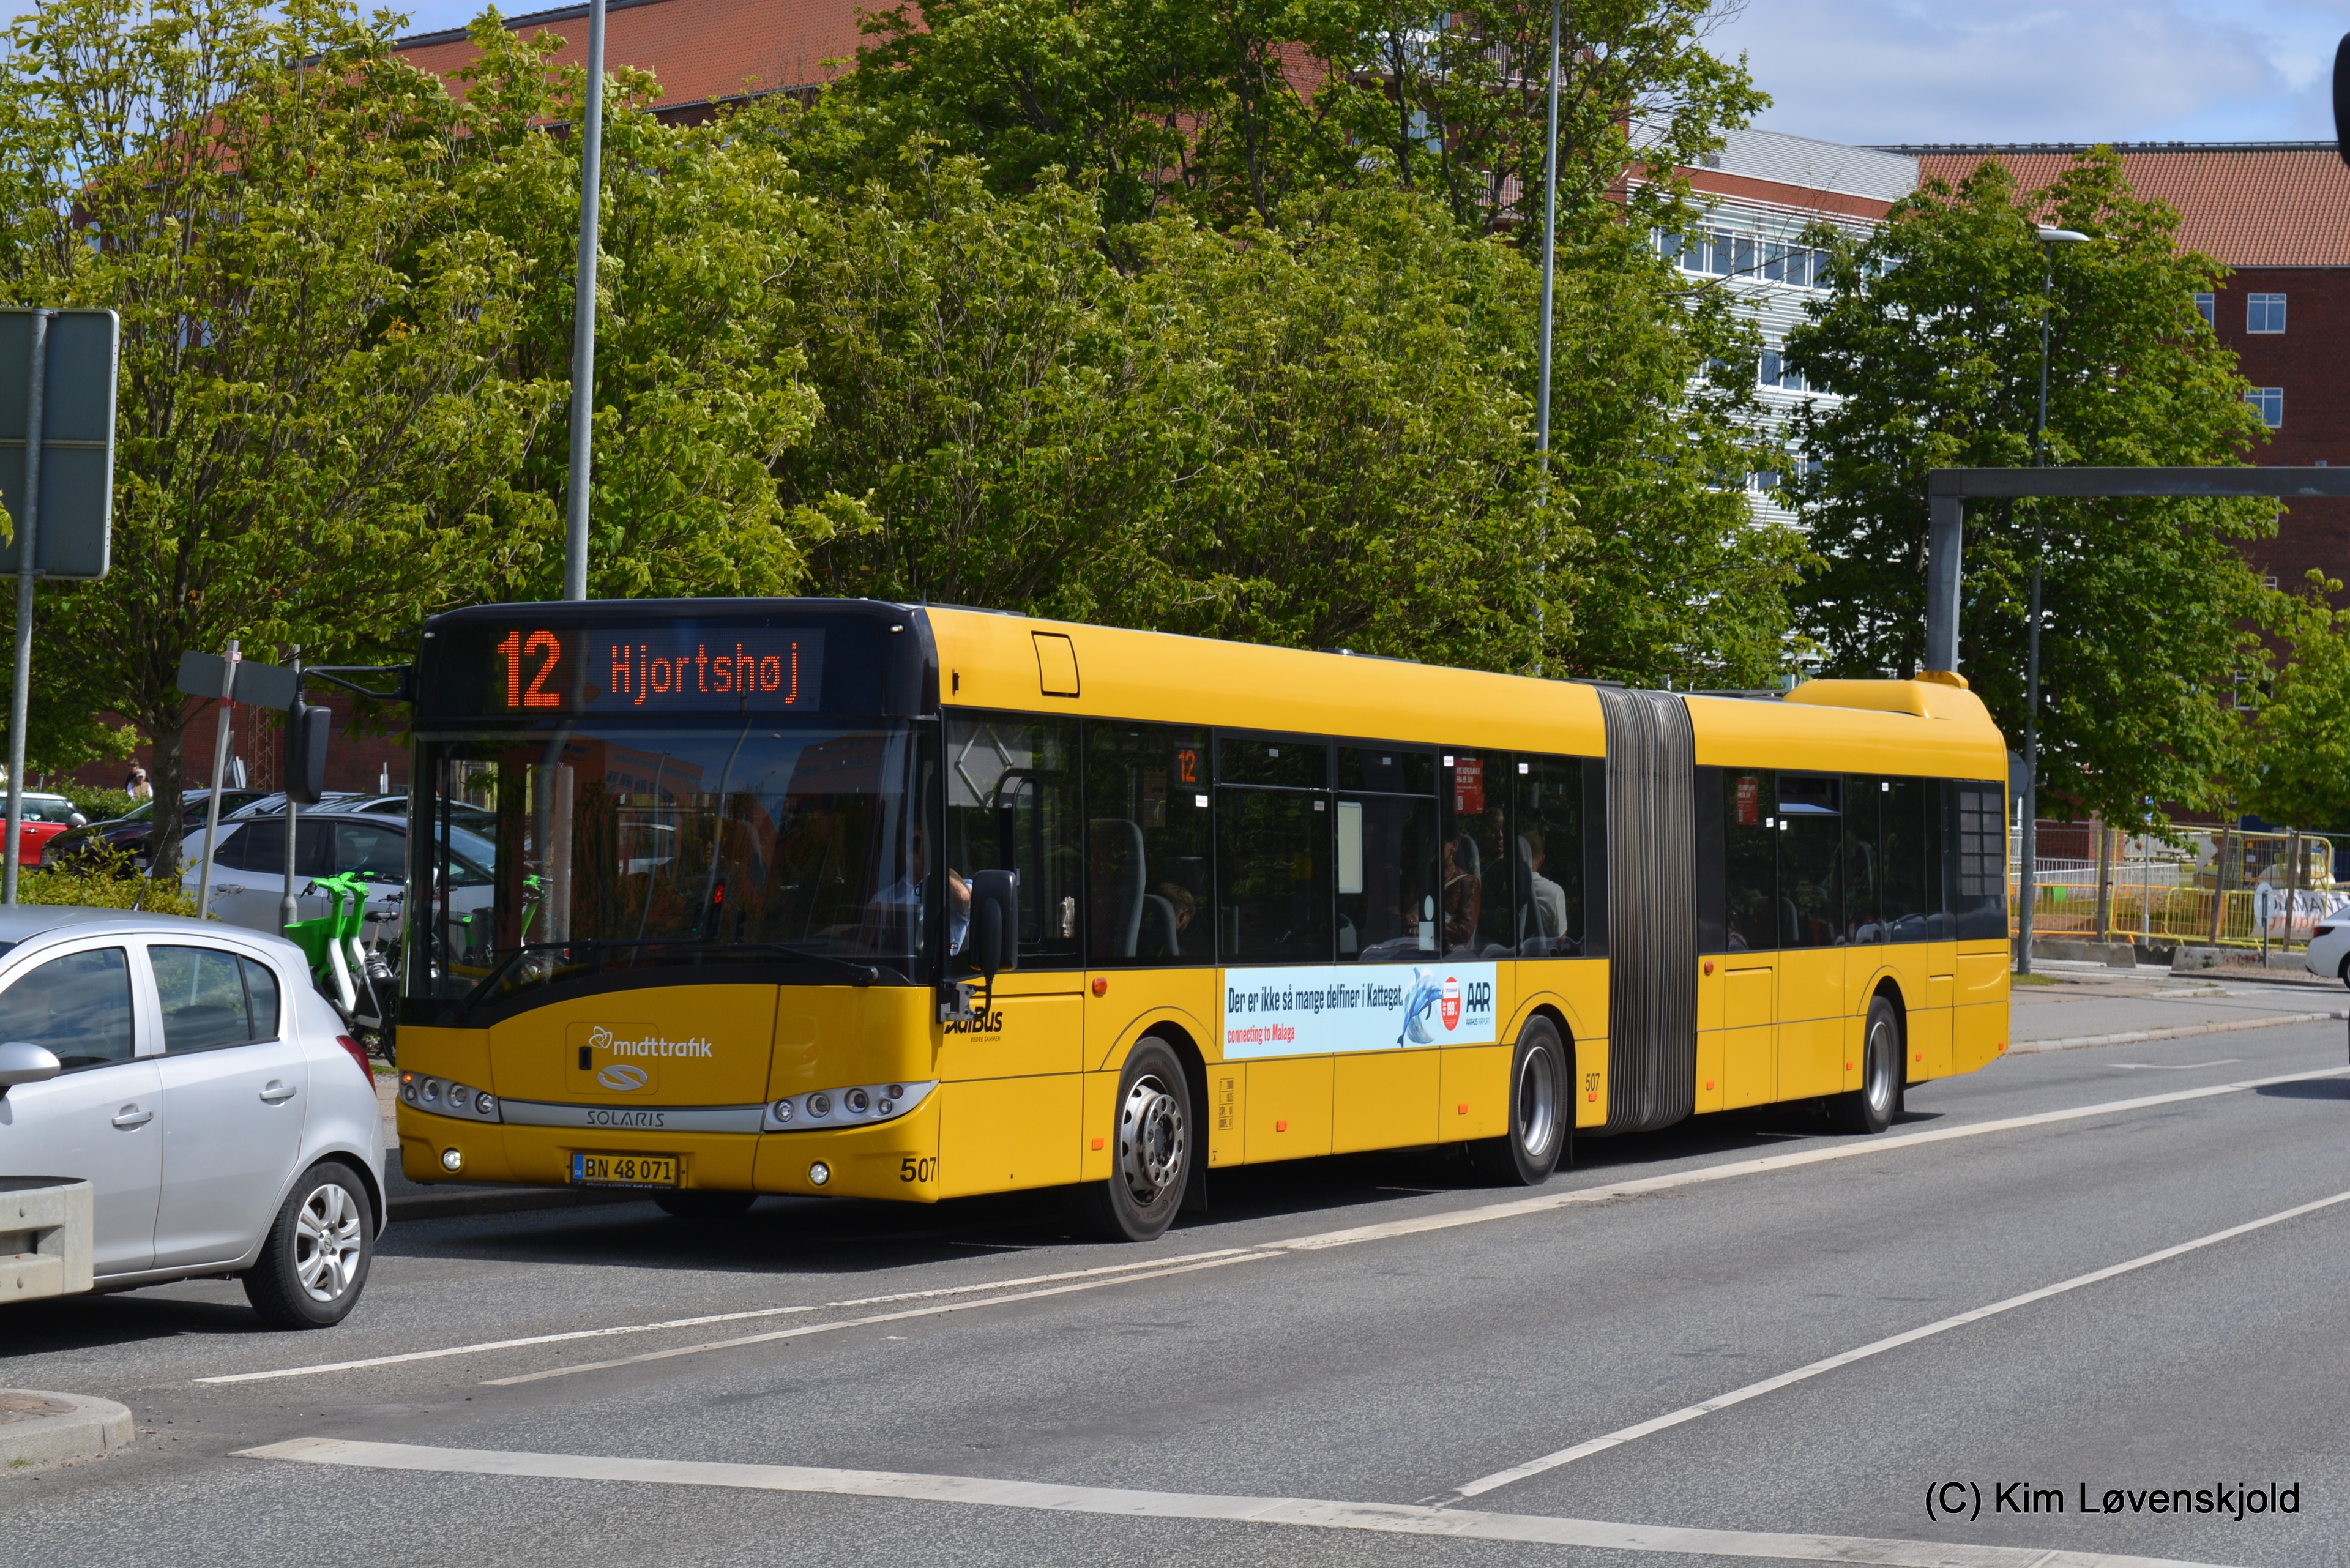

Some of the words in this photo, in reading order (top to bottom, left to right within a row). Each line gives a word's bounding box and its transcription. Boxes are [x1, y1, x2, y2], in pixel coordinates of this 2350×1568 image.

[497, 630, 561, 706] 12
[611, 643, 797, 705] Hjortshøj
[1178, 750, 1196, 782] 12
[1228, 987, 1245, 1014] Der
[1248, 992, 1258, 1012] er
[1261, 986, 1280, 1012] ikke
[1282, 984, 1292, 1011] så
[1296, 990, 1324, 1014] mange
[1327, 984, 1360, 1009] delfiner
[1362, 983, 1365, 1007] i
[1367, 982, 1404, 1011] Kattegat.
[1466, 982, 1491, 1013] AAR
[1228, 1025, 1263, 1045] connecting
[1264, 1026, 1270, 1041] to
[1272, 1023, 1295, 1043] Malaga
[613, 1036, 713, 1058] midttrafik
[1586, 1072, 1600, 1092] 507
[587, 1111, 665, 1127] SOLARIS
[586, 1159, 608, 1178] BN
[614, 1159, 635, 1179] 48
[640, 1160, 671, 1180] 071
[900, 1157, 936, 1183] 507
